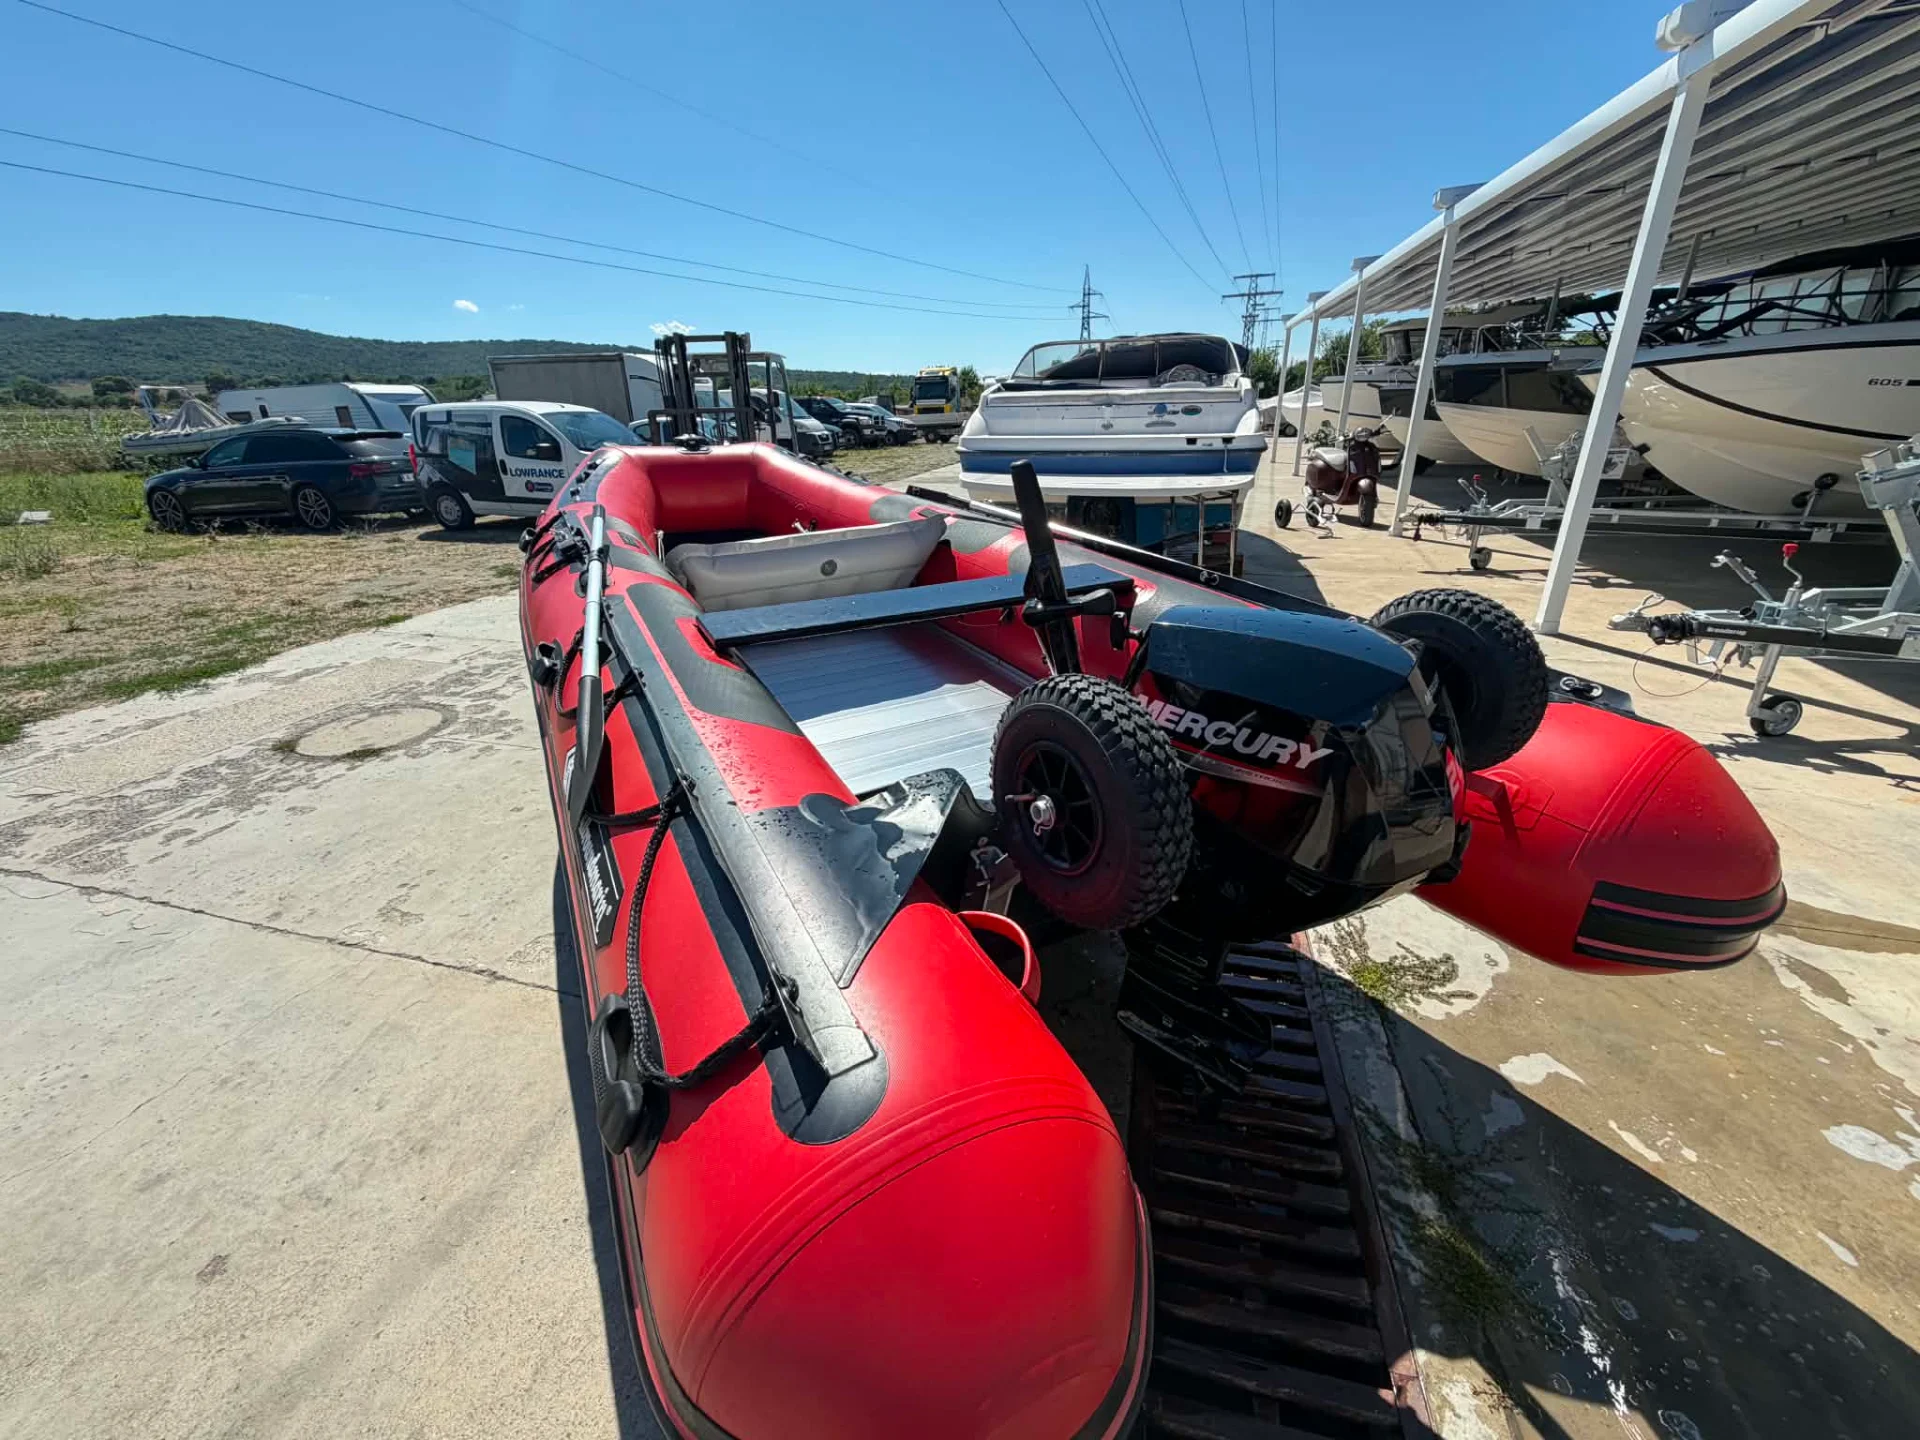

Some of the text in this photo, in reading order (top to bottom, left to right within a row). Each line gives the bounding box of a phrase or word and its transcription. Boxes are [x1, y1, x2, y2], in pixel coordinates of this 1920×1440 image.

[1868, 378, 1903, 386] 605
[509, 467, 566, 478] LOWRANCE
[1139, 694, 1334, 769] MERCURY
